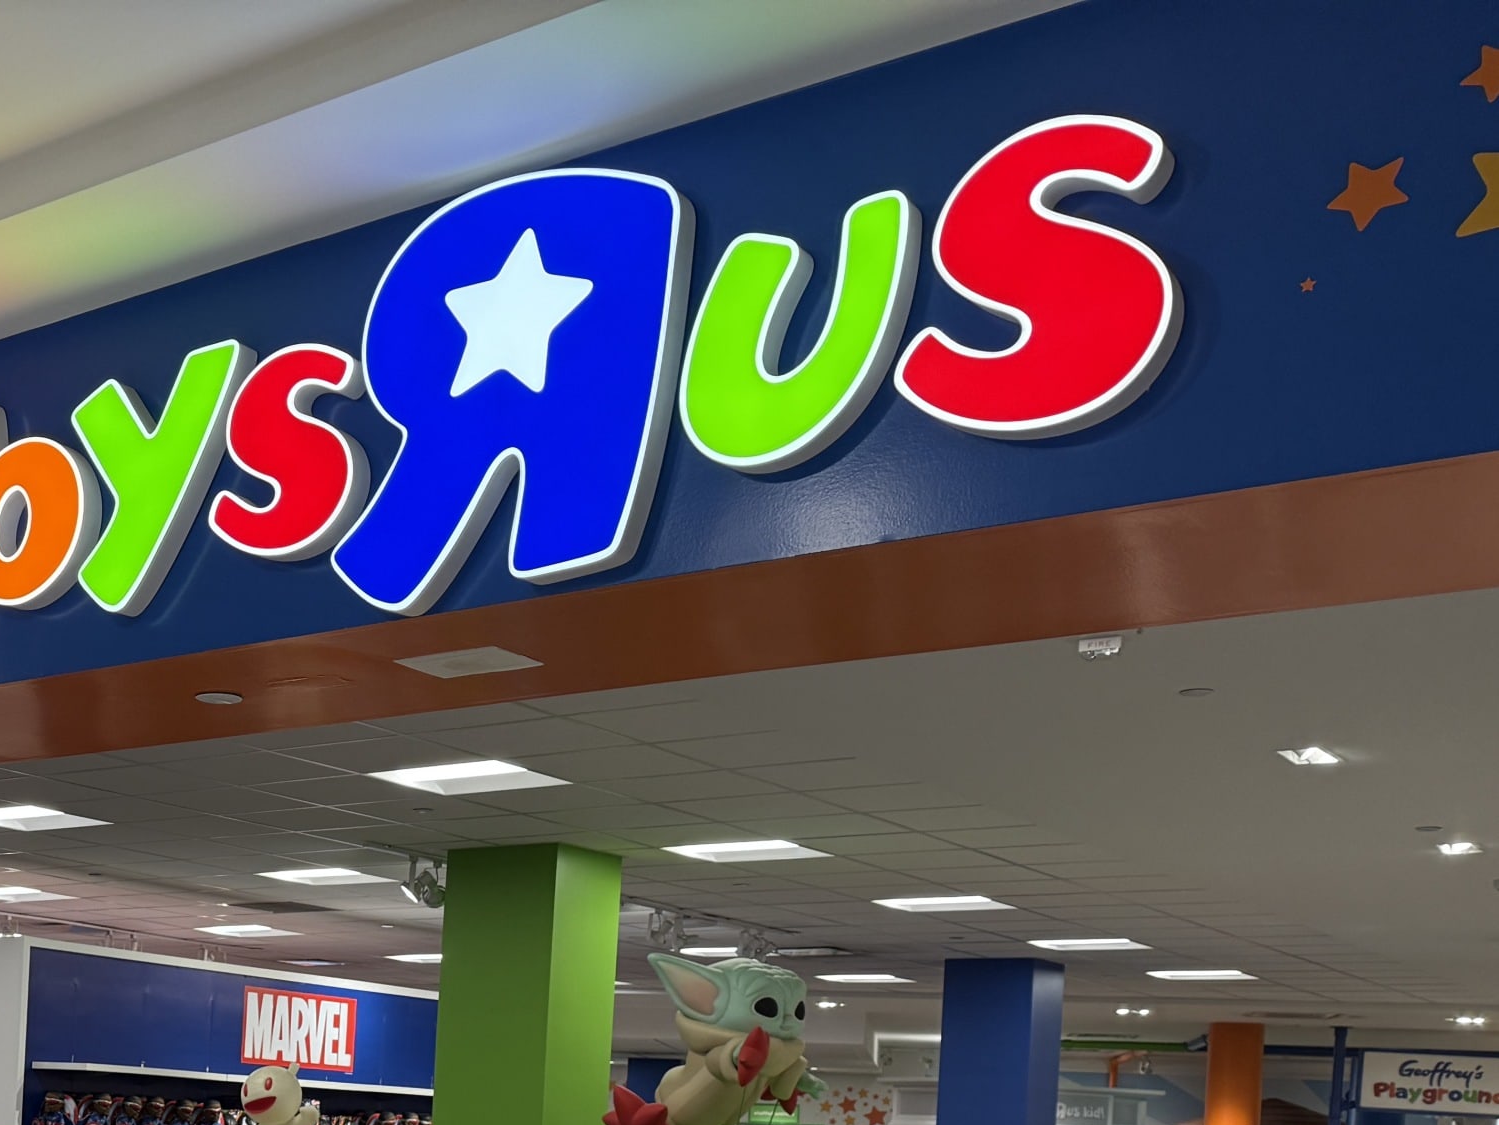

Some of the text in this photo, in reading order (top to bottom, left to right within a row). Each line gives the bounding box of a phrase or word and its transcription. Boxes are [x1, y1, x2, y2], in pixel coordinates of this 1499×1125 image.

[1087, 639, 1113, 649] FIRE
[244, 991, 352, 1067] MARVEL
[1398, 1060, 1484, 1089] Geoffrey's
